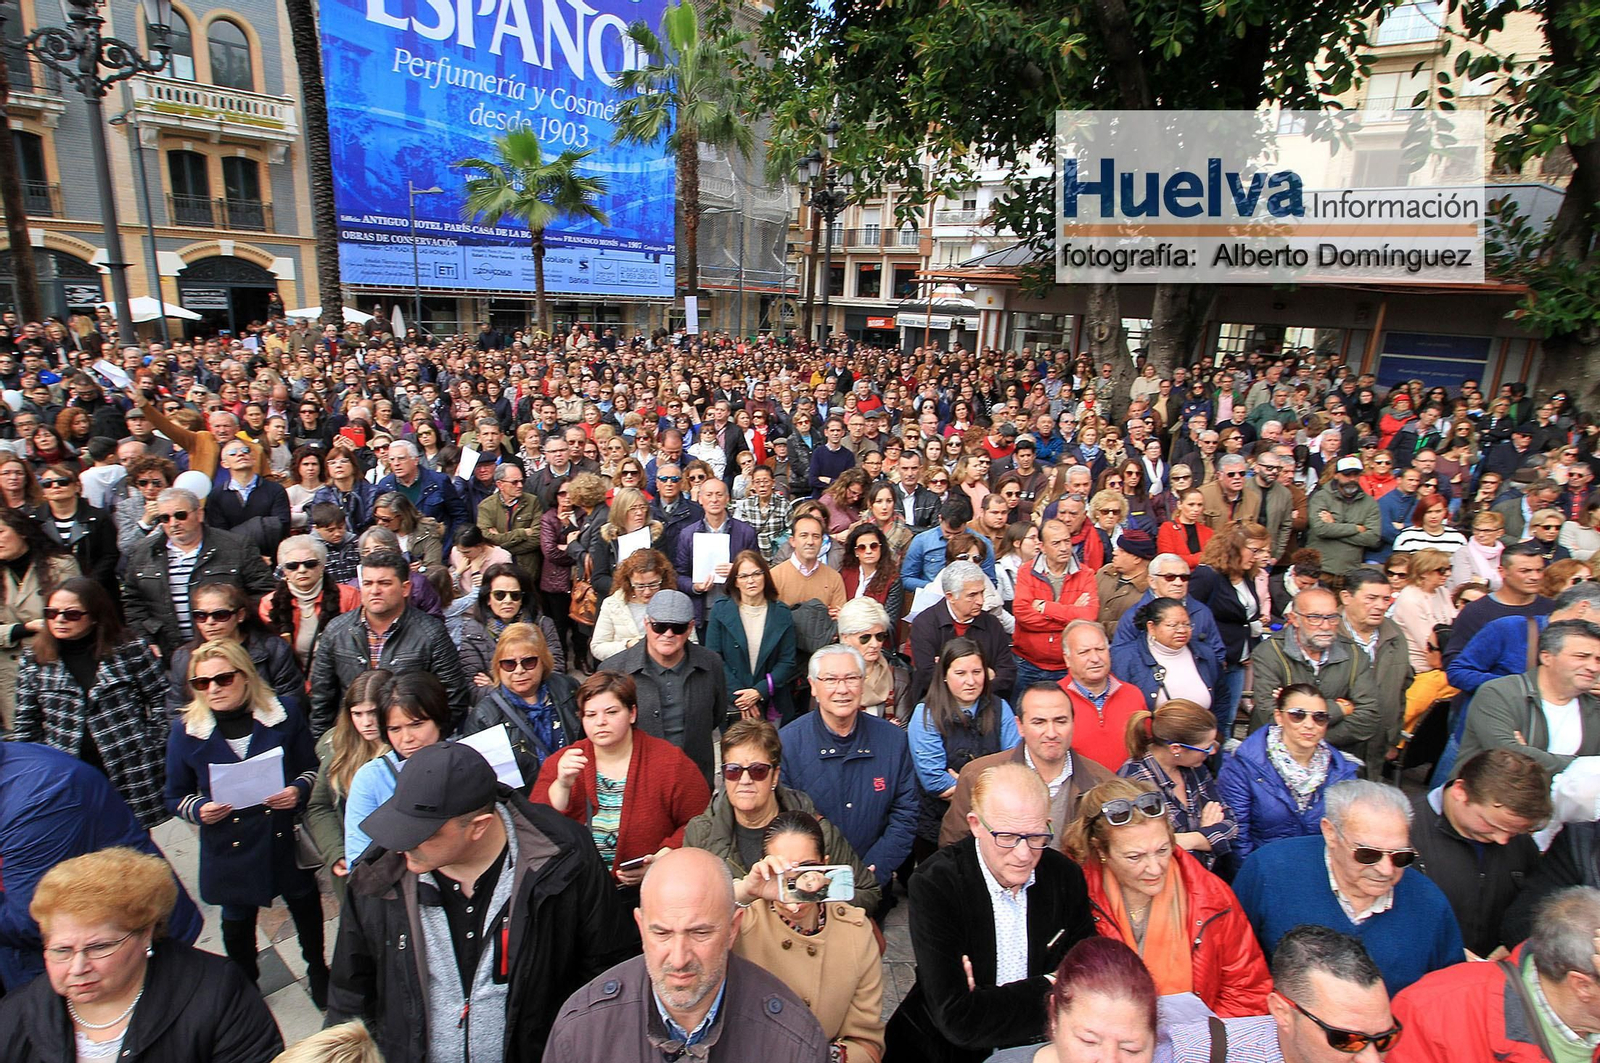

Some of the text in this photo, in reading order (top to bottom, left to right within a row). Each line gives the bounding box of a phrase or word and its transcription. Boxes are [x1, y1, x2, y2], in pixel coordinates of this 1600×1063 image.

[392, 47, 621, 122] Perfumería y Cosmé
[469, 102, 590, 148] desde 1903
[342, 230, 375, 241] OBRAS
[376, 233, 390, 243] DE
[391, 235, 458, 248] CONSERVACIÓN
[362, 215, 409, 227] ANTIGUO
[410, 219, 443, 231] HOTEL
[495, 228, 508, 236] DE
[509, 229, 520, 238] LA
[563, 235, 598, 245] FRANCISCO
